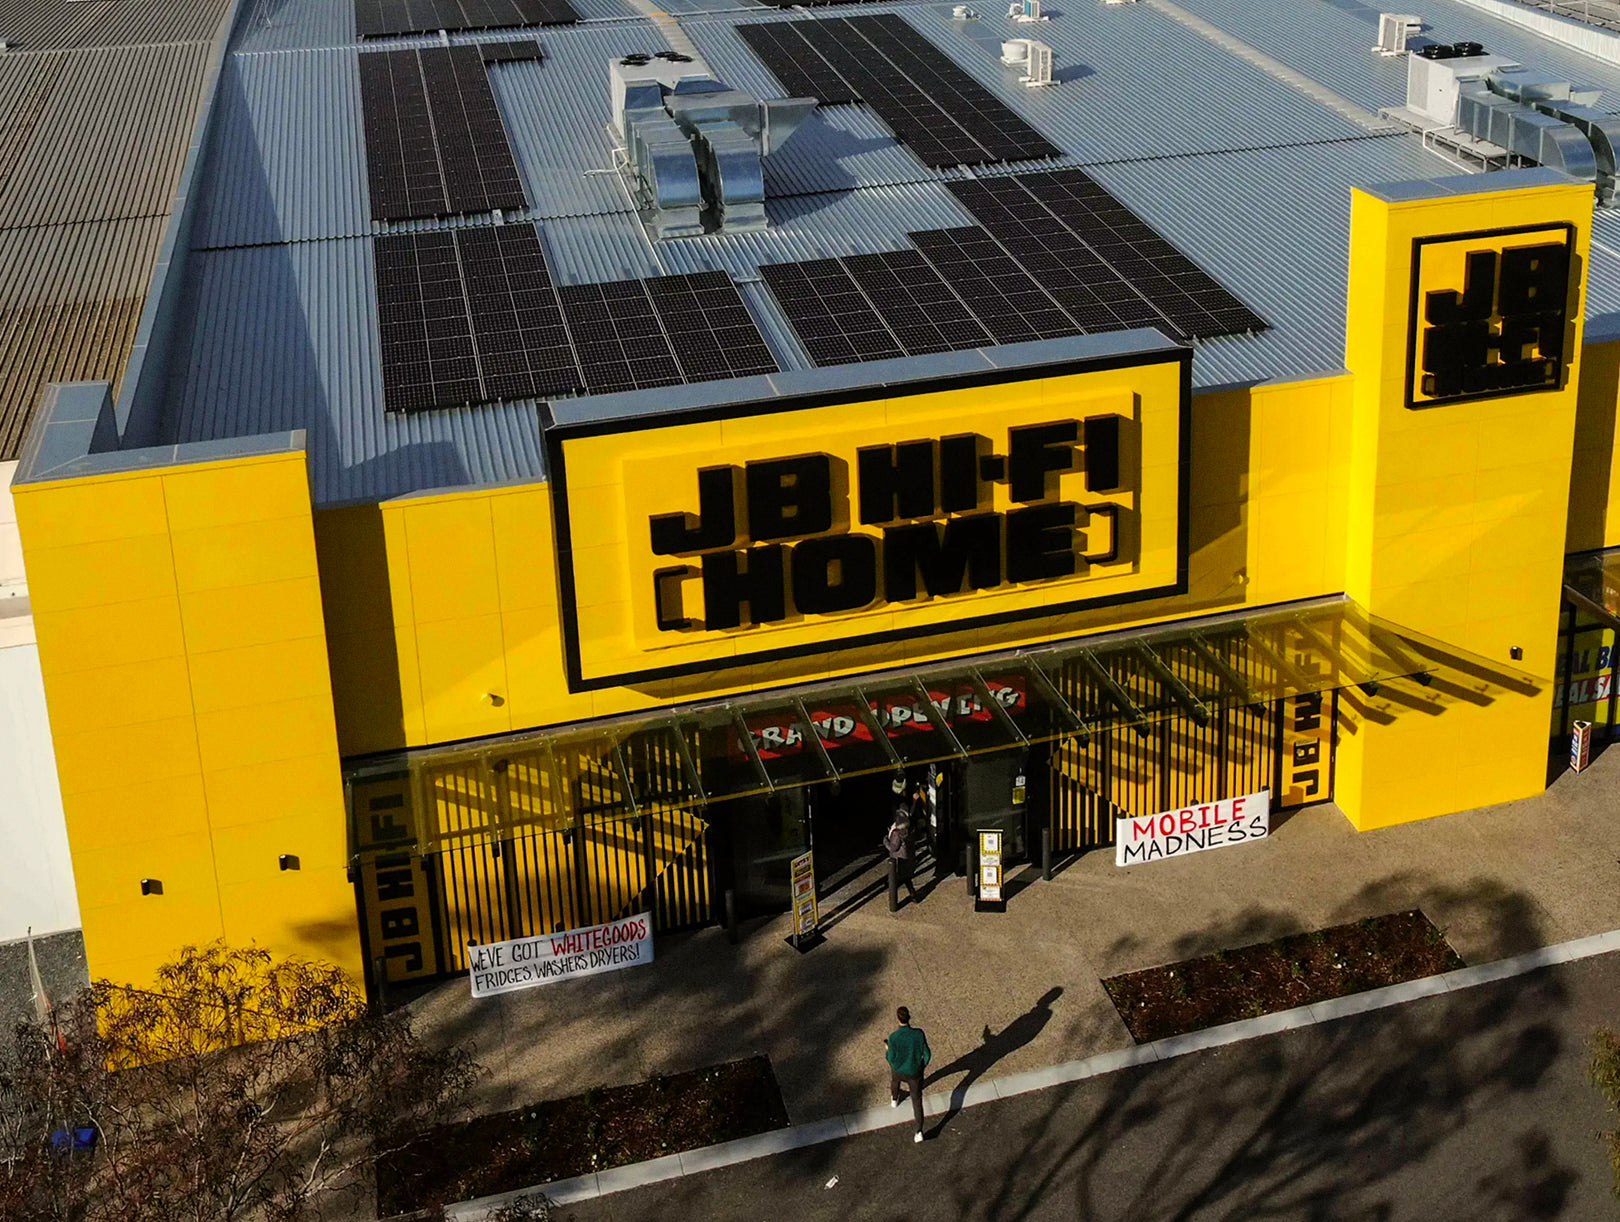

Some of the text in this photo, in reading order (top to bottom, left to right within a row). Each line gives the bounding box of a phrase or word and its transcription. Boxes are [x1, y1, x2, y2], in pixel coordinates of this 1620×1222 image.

[1425, 241, 1568, 325] JB
[648, 414, 1122, 556] JB HI-FI
[1292, 737, 1320, 797] JB
[1123, 815, 1268, 864] MADNESS
[1132, 797, 1247, 842] MOBILE
[380, 906, 424, 972] JB
[512, 940, 543, 963] GOT
[550, 918, 647, 957] WHITEGOODS
[589, 943, 642, 970] DRYERS!
